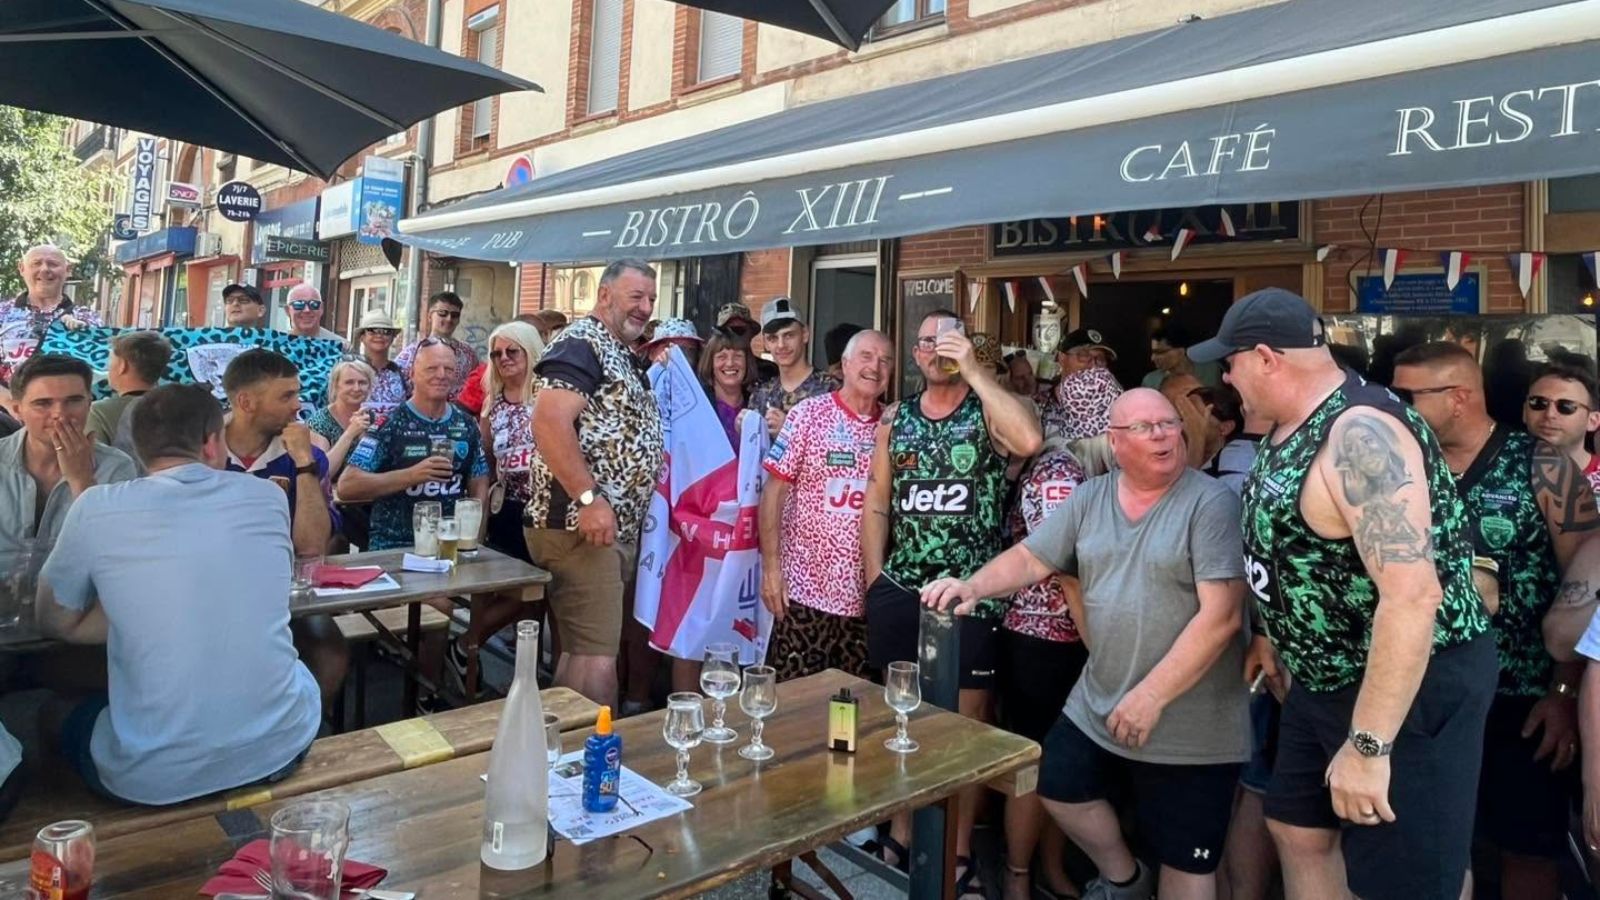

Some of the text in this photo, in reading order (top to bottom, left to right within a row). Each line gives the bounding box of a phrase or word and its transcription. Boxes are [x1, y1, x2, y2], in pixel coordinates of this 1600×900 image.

[1387, 80, 1600, 156] REST
[1120, 123, 1276, 183] CAFÉ
[133, 139, 154, 229] VOYAGES
[219, 194, 259, 208] LAVERIE
[614, 174, 895, 248] BISTRÔ XIII
[267, 238, 329, 258] EPICERIE
[482, 231, 523, 249] PUB
[905, 278, 954, 297] WELCOME
[11, 342, 33, 360] Je
[829, 484, 865, 510] Je
[901, 484, 969, 512] Jet2
